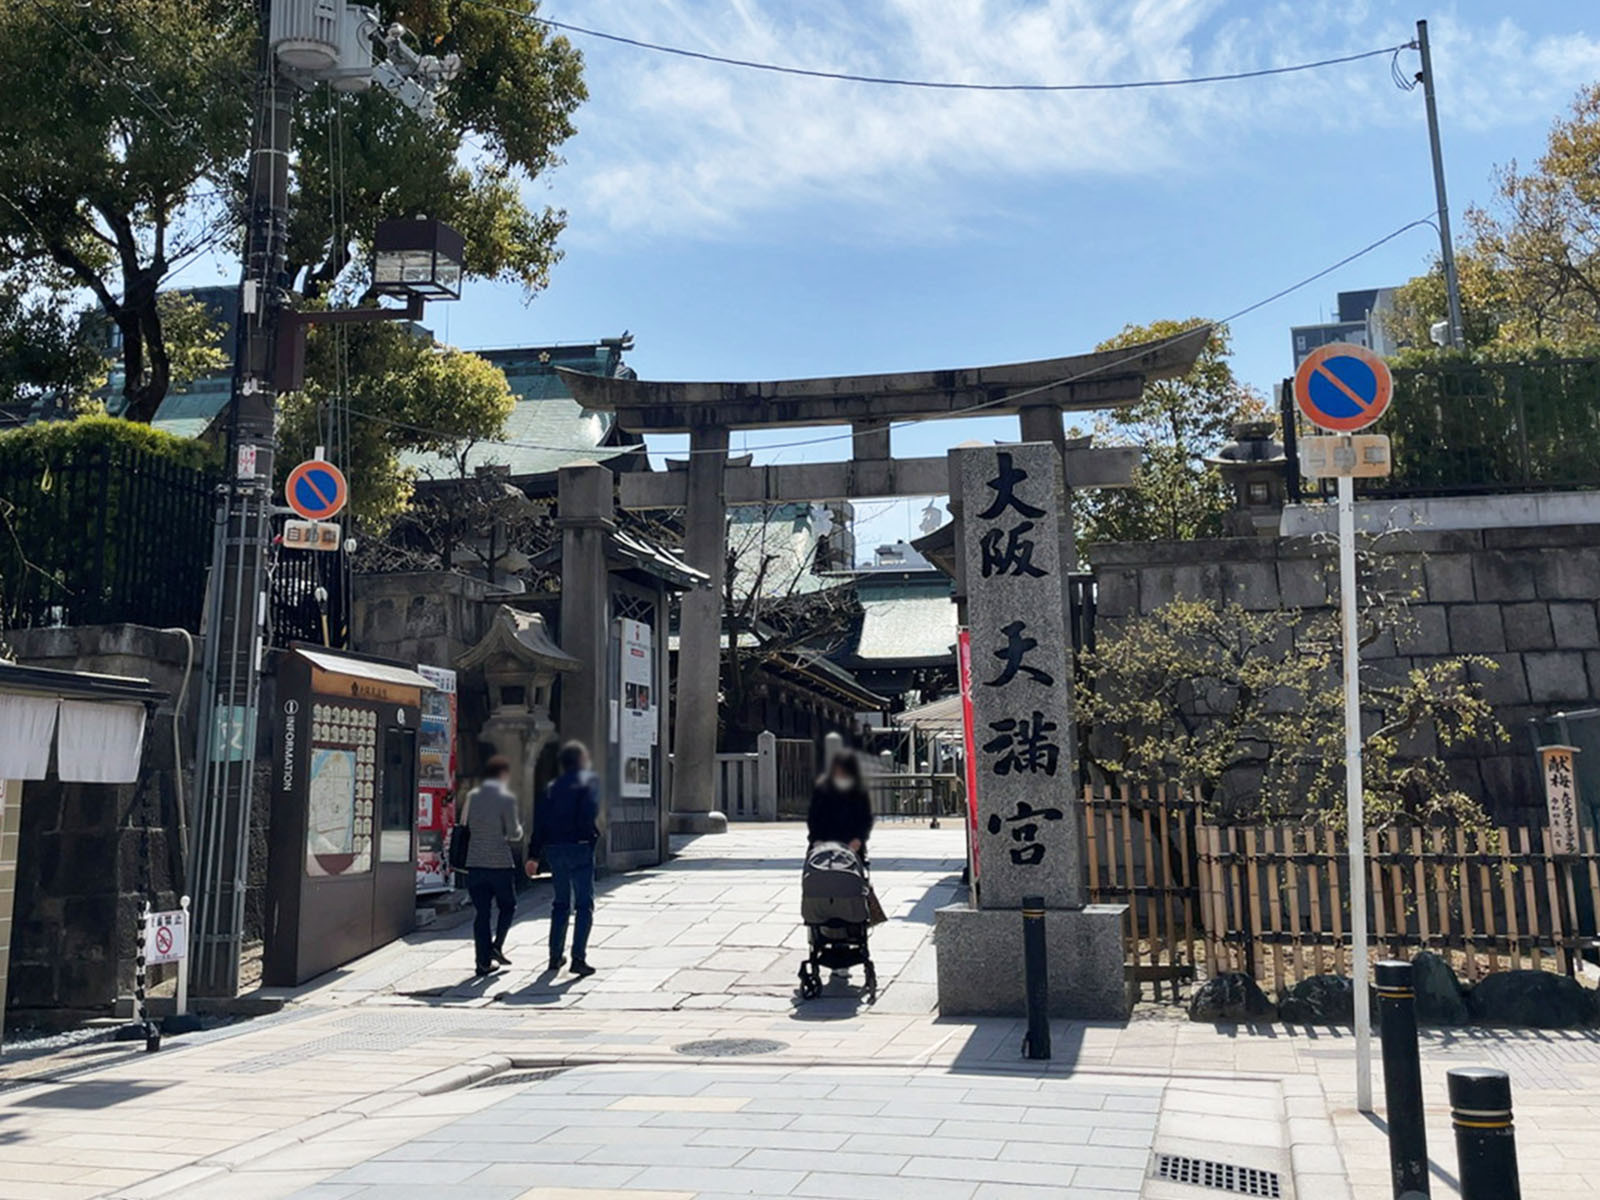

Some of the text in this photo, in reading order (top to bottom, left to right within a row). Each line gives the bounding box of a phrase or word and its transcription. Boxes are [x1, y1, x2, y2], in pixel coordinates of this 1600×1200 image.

[283, 715, 297, 792] INFORMATION
[977, 452, 1064, 867] 大阪天満宮
